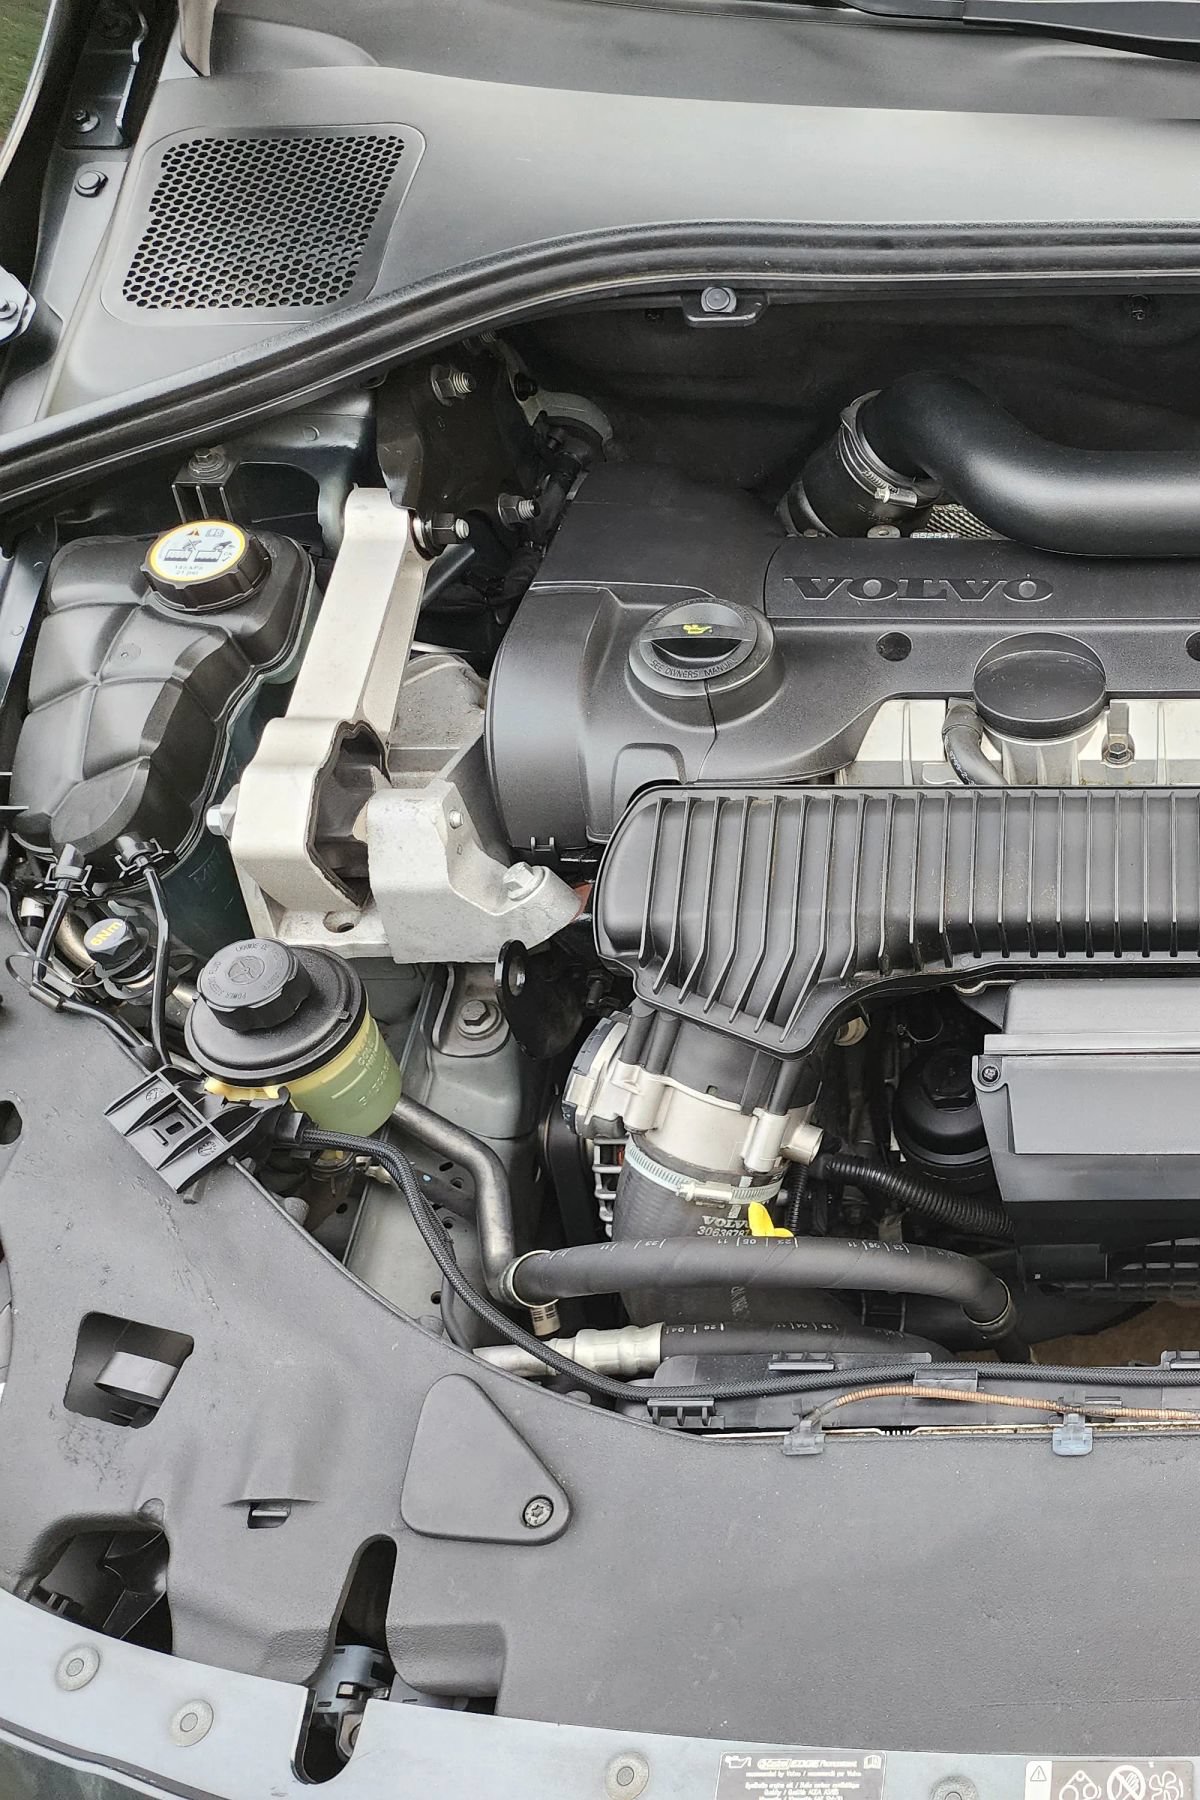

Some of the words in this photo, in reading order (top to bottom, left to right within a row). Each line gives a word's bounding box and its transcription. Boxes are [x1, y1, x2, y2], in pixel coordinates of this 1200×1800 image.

[784, 576, 1053, 602] VOLVO
[651, 660, 663, 671] SEE
[703, 658, 738, 677] MANUAL
[90, 921, 122, 947] 6Nm
